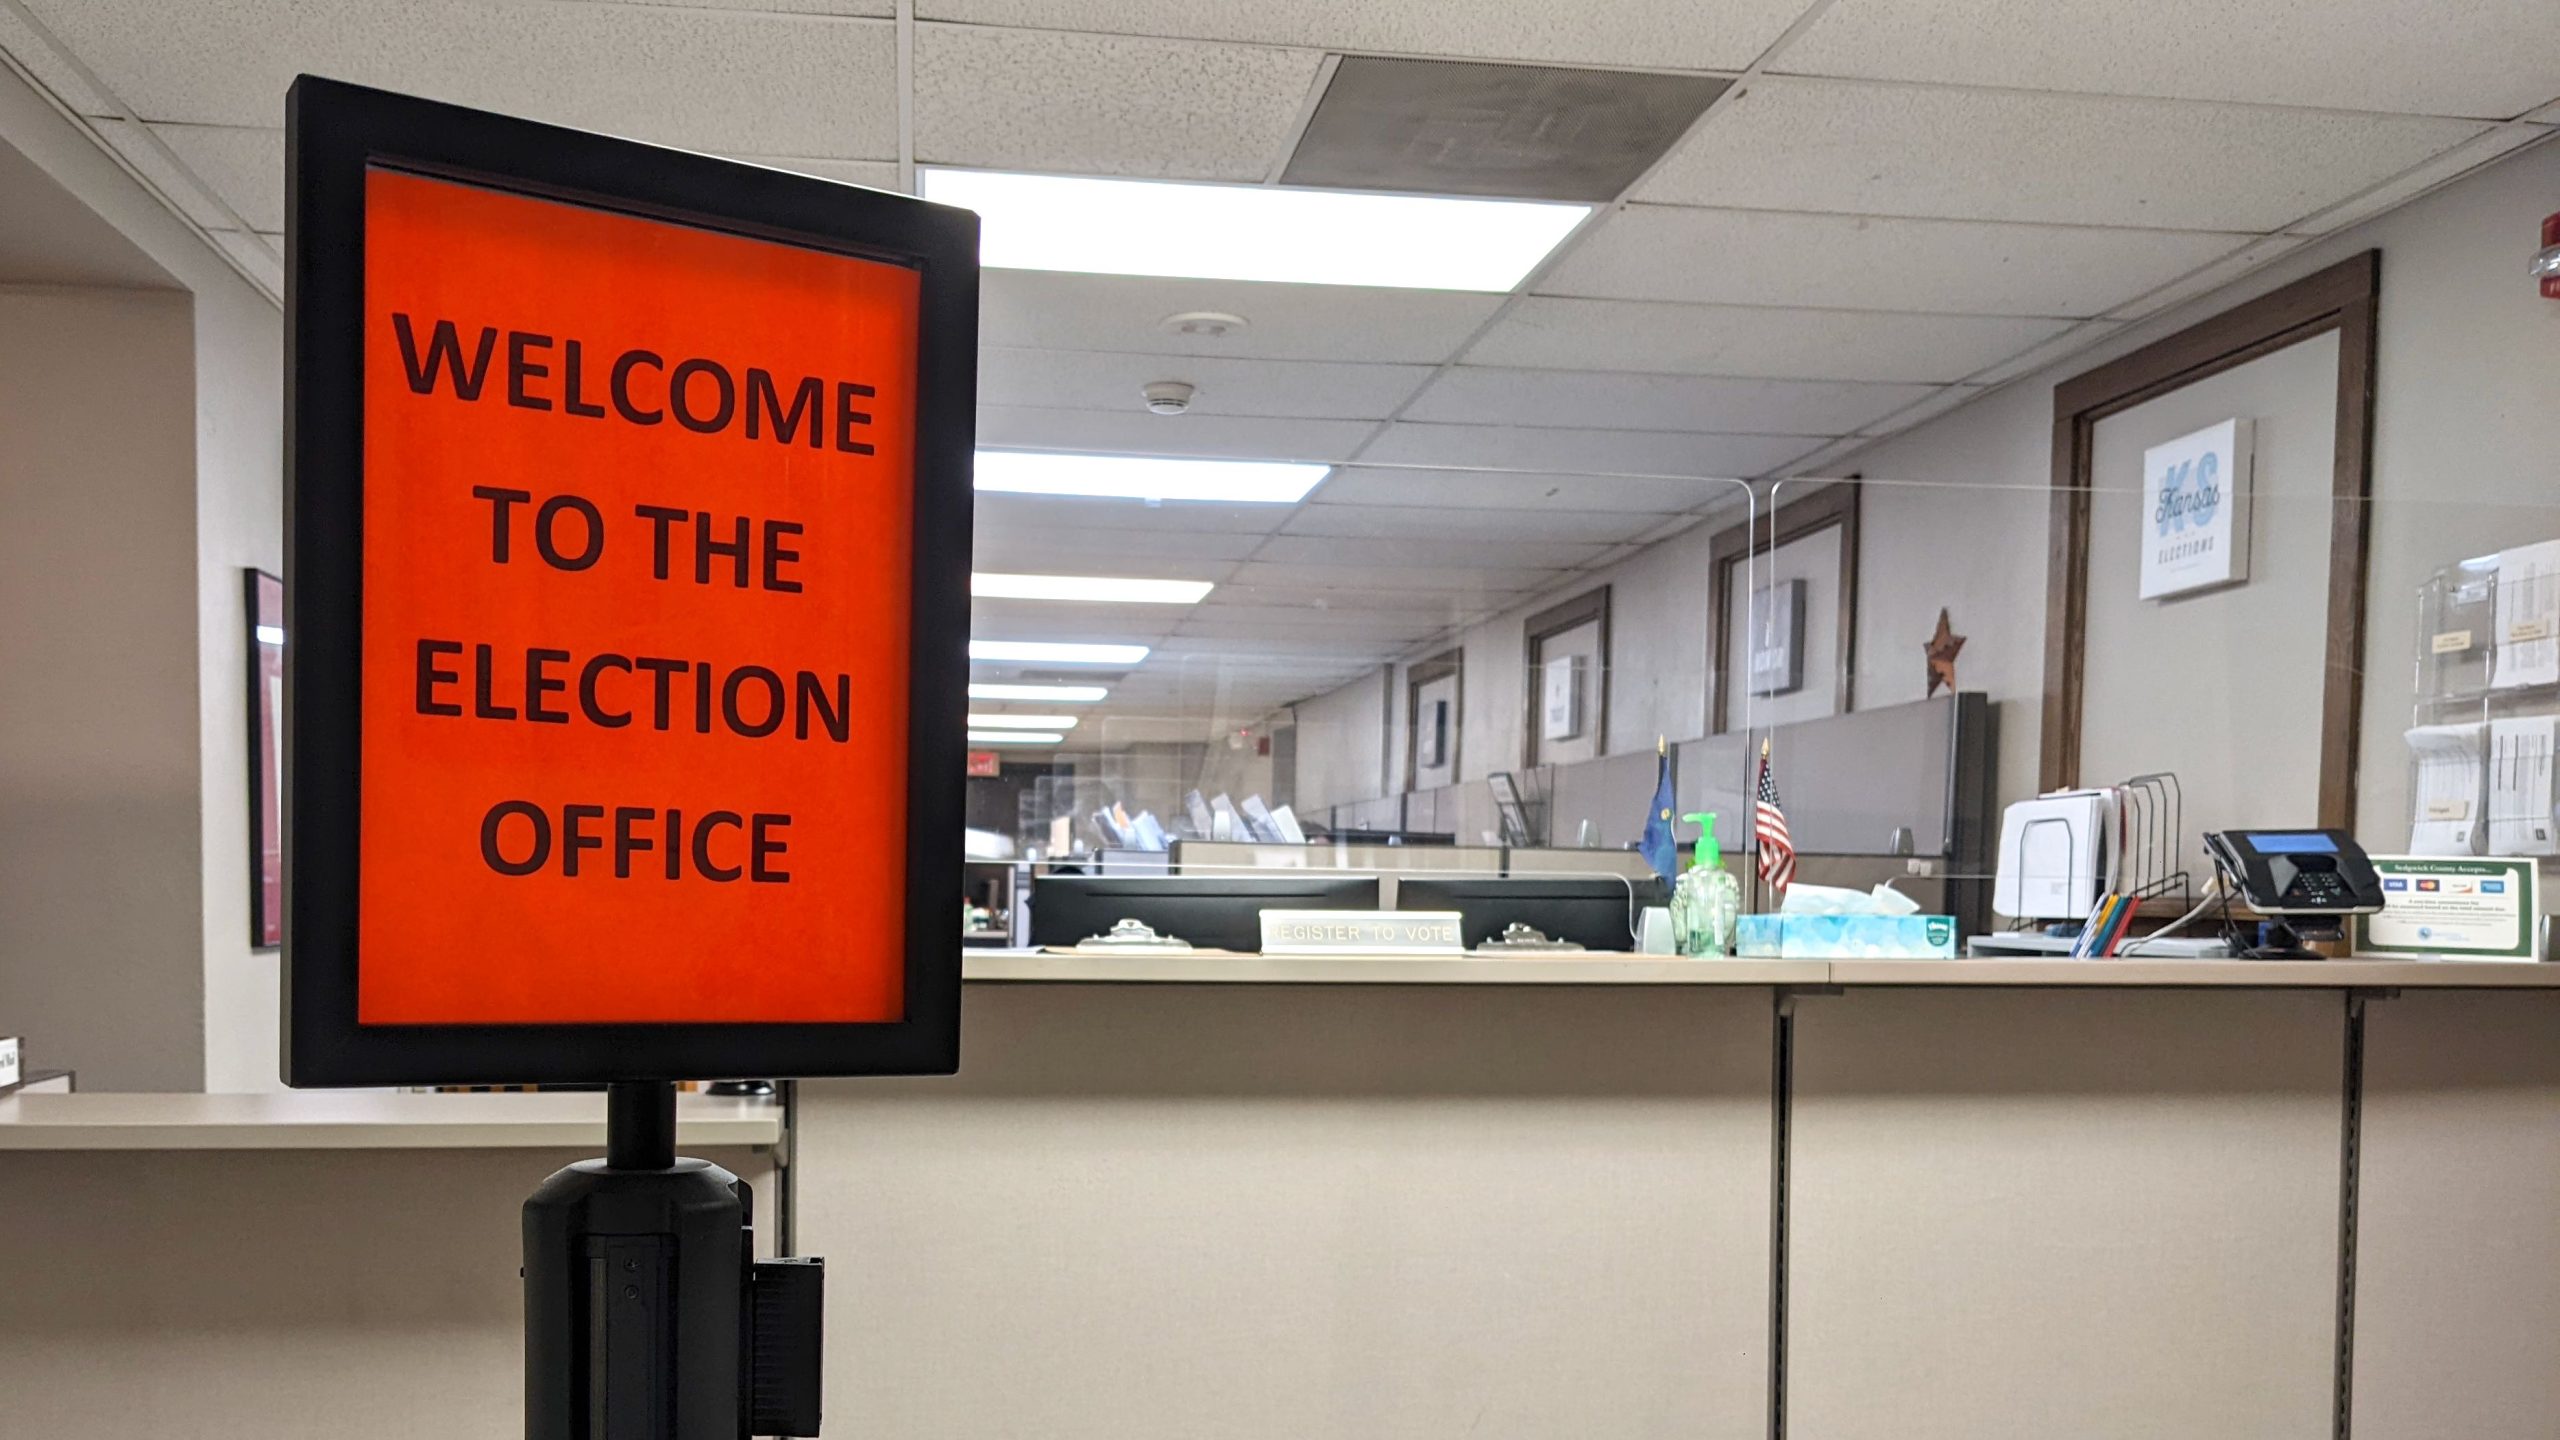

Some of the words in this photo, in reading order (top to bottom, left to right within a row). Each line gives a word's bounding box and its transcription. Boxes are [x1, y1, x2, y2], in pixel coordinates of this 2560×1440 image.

[391, 312, 876, 456] WELCOME
[2155, 483, 2220, 524] Kansas
[2160, 451, 2218, 538] KS
[472, 485, 605, 571] TO
[635, 504, 804, 594] THE
[2157, 536, 2215, 565] ELECTIONS
[415, 638, 851, 743] ELECTION
[479, 800, 792, 884] OFFICE
[1372, 926, 1395, 942] TO
[1405, 926, 1455, 942] VOTE
